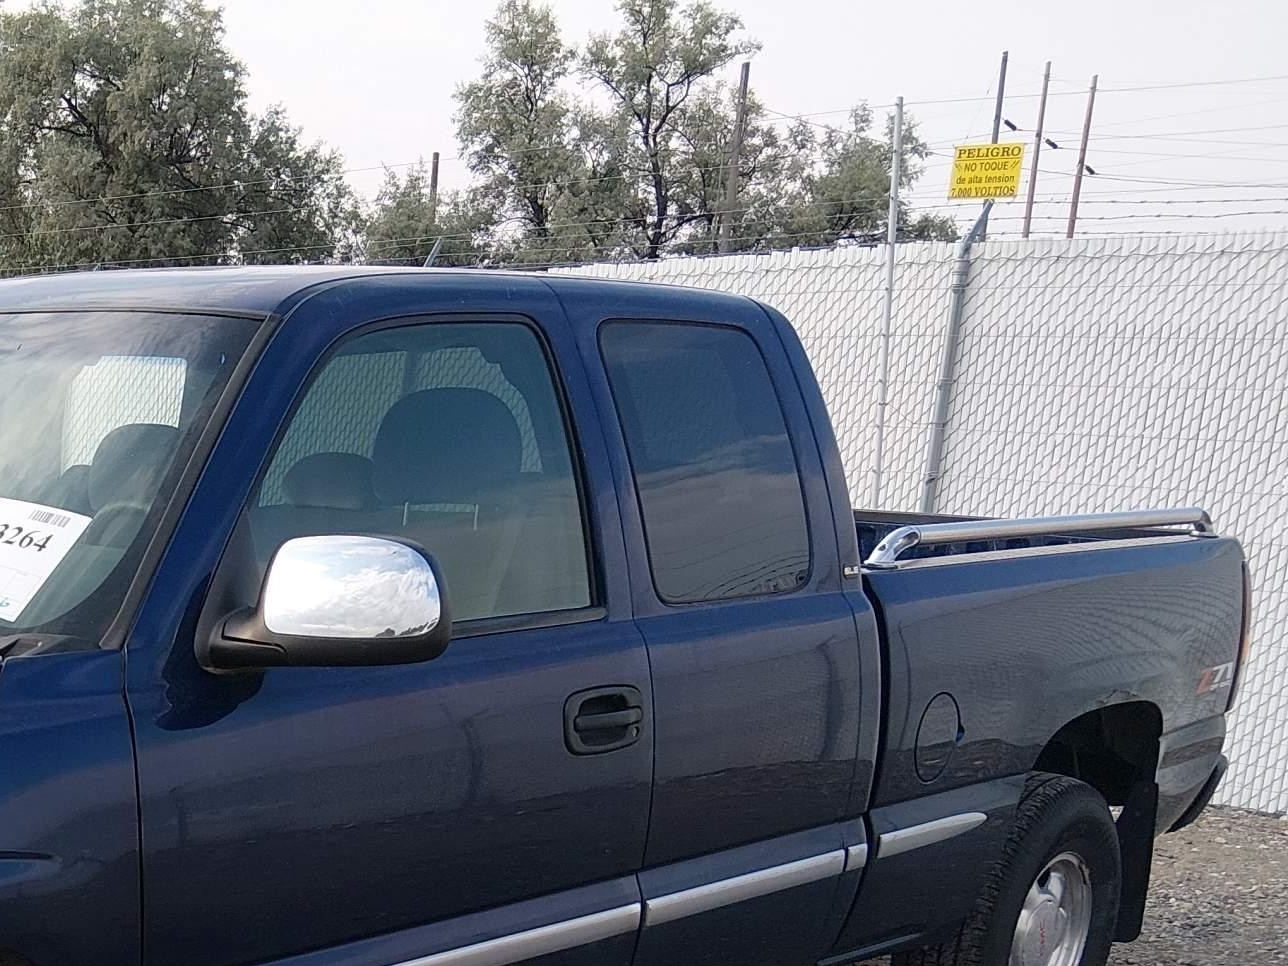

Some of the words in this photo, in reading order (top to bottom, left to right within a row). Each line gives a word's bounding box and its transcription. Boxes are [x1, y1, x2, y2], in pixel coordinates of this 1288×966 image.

[957, 146, 1022, 159] PELIGRO
[964, 162, 977, 173] NO
[980, 161, 1010, 172] TOQUE
[956, 175, 966, 185] de
[968, 175, 982, 184] alta
[984, 174, 1015, 184] tension
[974, 185, 1016, 197] VOLTIOS
